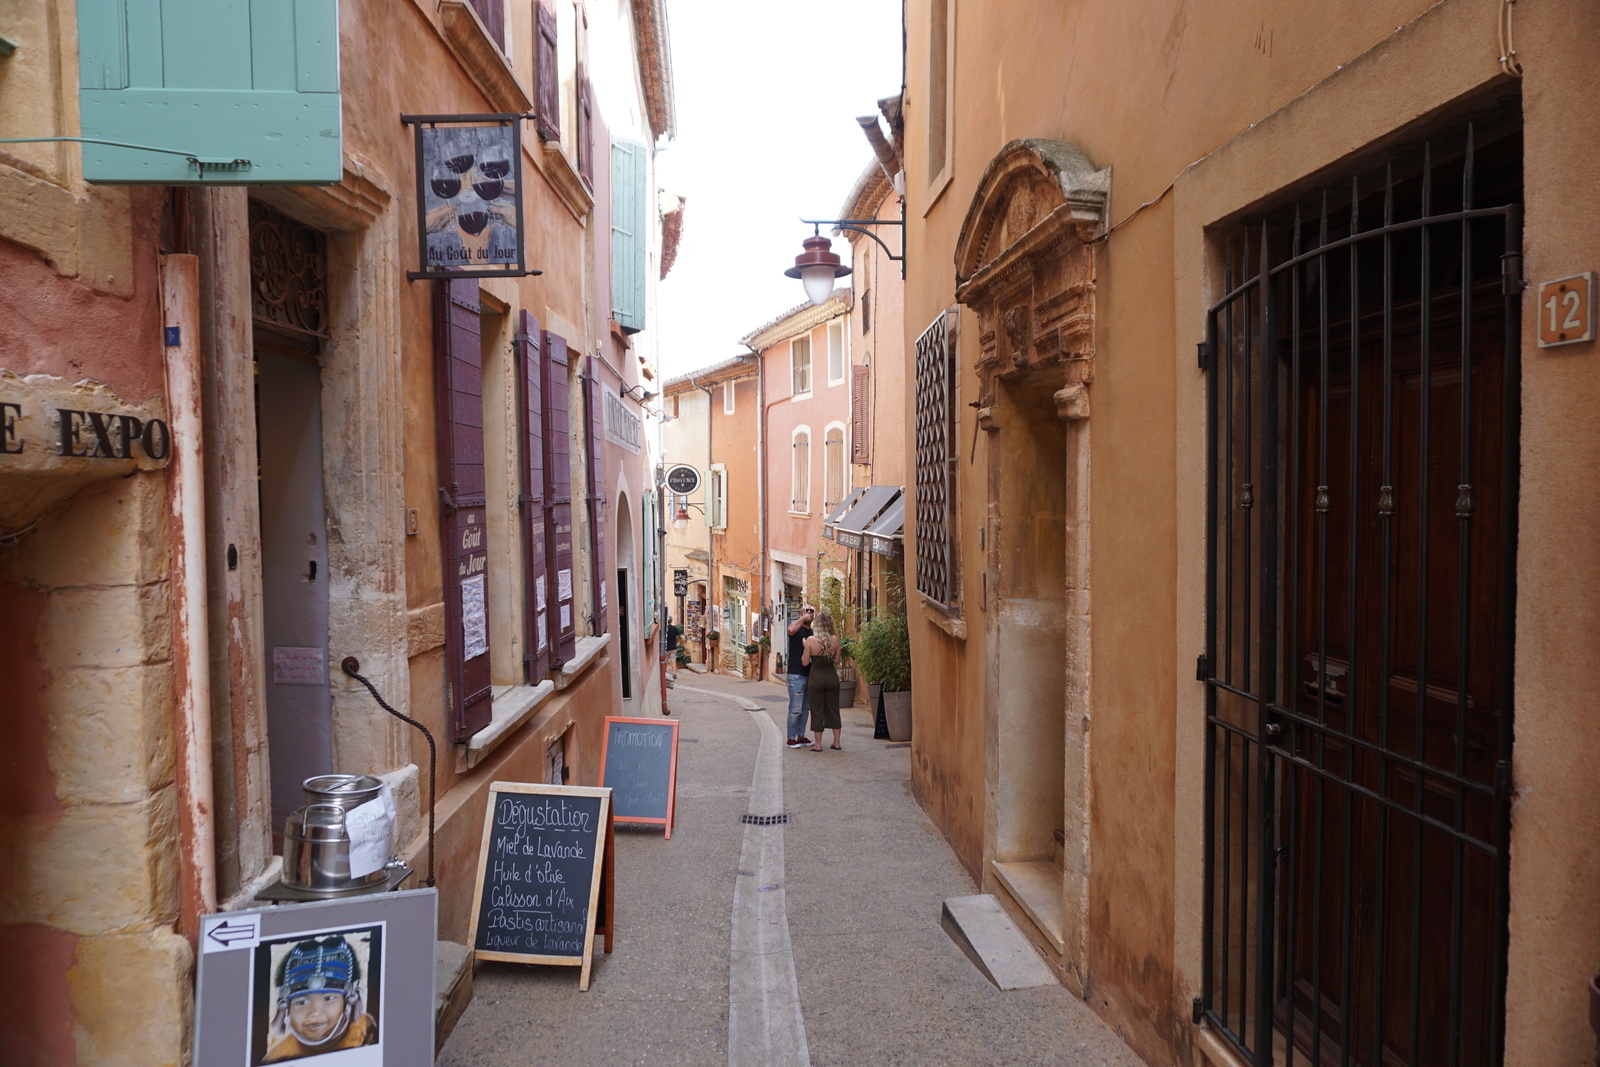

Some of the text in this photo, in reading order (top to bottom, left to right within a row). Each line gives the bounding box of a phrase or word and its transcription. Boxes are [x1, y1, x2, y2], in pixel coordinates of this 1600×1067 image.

[428, 244, 516, 261] Au Goût du Jour
[1545, 290, 1581, 333] 12
[56, 408, 170, 460] EXPO
[462, 526, 481, 549] Goût
[466, 553, 486, 575] Jour
[497, 798, 593, 838] Dégustation
[496, 836, 587, 860] Miel de Lavande
[493, 860, 566, 884] Huile d'olive
[491, 883, 574, 910] Calisson d'Aix
[487, 908, 588, 935] Pastis artisanal
[485, 931, 585, 953] Liqueur de Lavande
